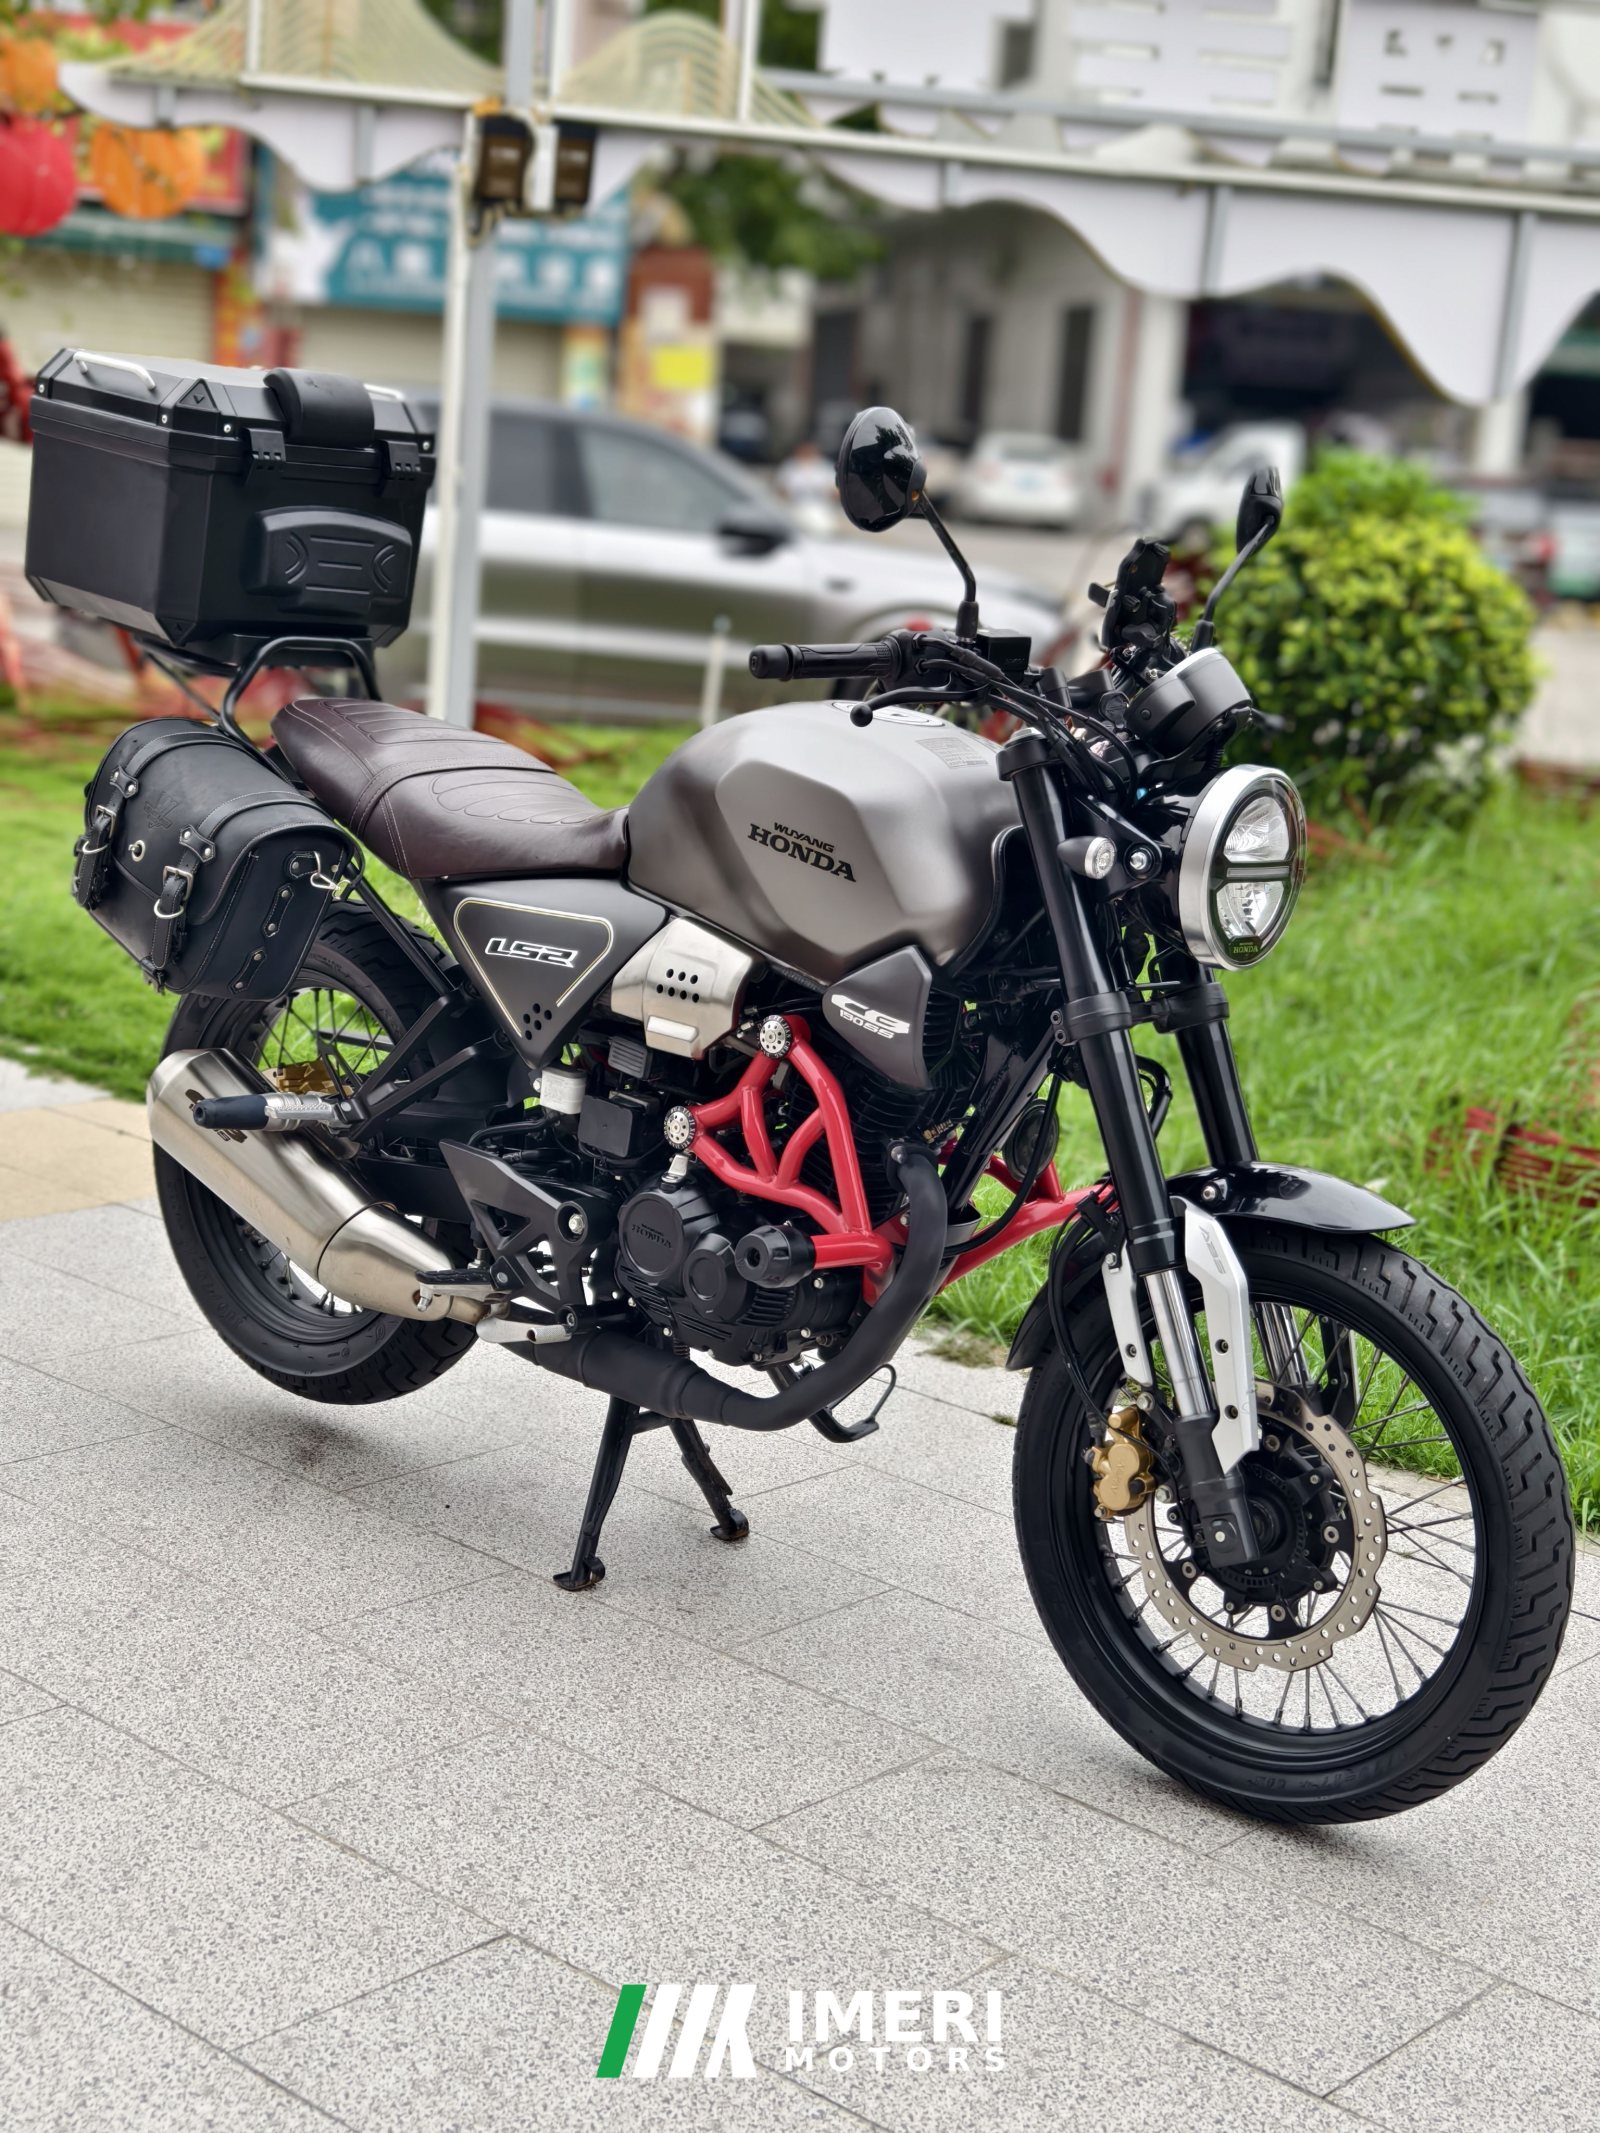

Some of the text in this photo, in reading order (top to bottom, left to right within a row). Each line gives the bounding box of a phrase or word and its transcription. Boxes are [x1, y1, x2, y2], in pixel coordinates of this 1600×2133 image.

[774, 821, 835, 853] WUYANG
[747, 823, 857, 883] HONDA
[484, 937, 579, 968] LS2
[1233, 945, 1259, 954] HONDA
